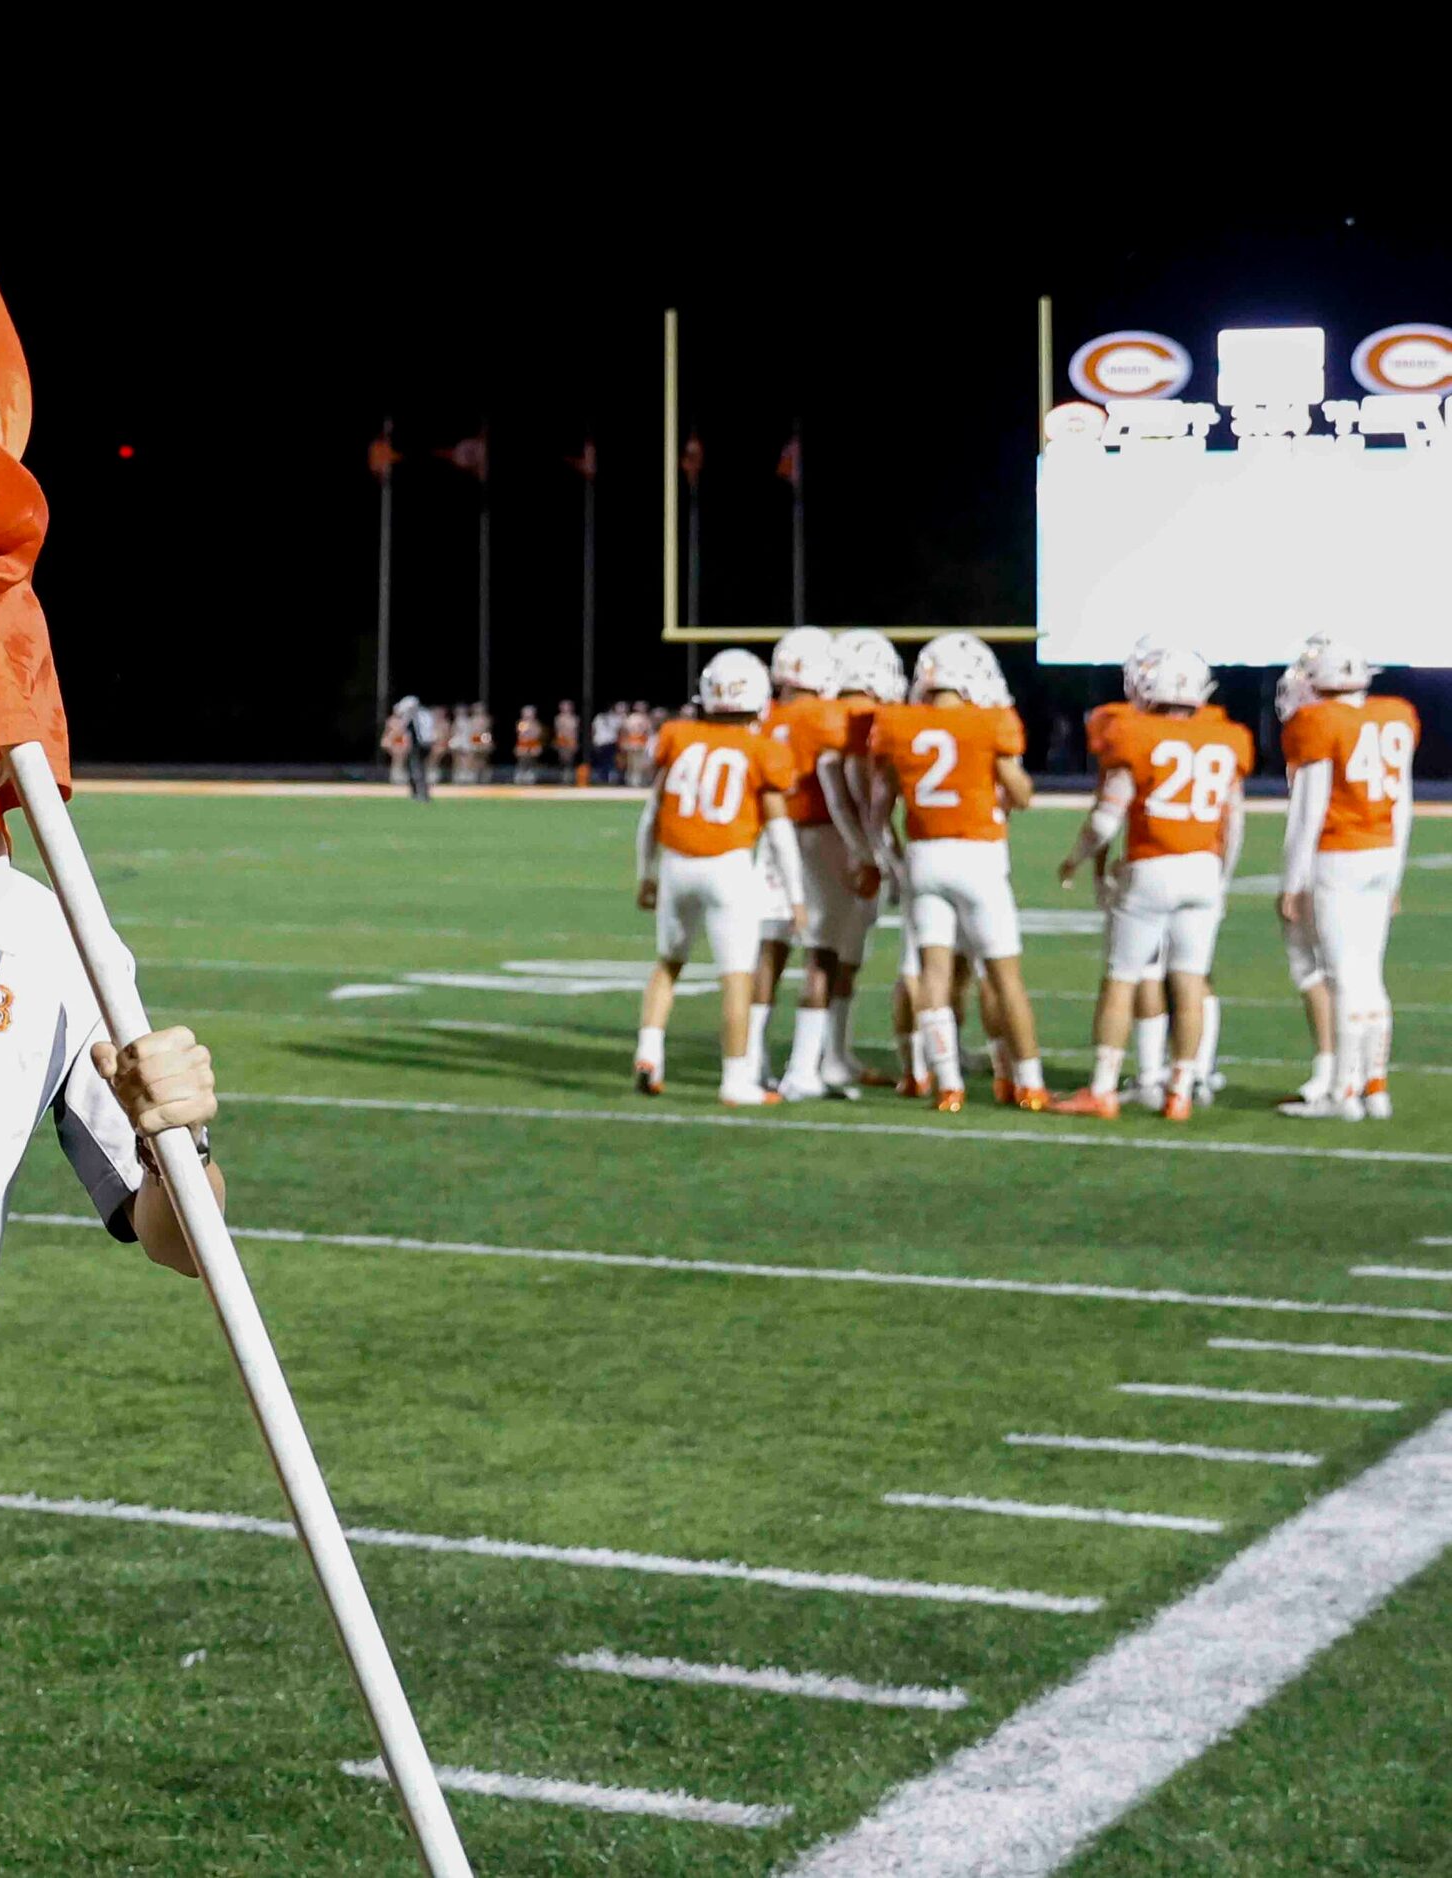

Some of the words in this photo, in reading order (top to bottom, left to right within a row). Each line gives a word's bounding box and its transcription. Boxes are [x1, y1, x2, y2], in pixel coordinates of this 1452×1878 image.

[665, 742, 748, 823] 40
[913, 731, 960, 807] 2
[1145, 740, 1236, 822] 28
[1345, 721, 1415, 802] 49
